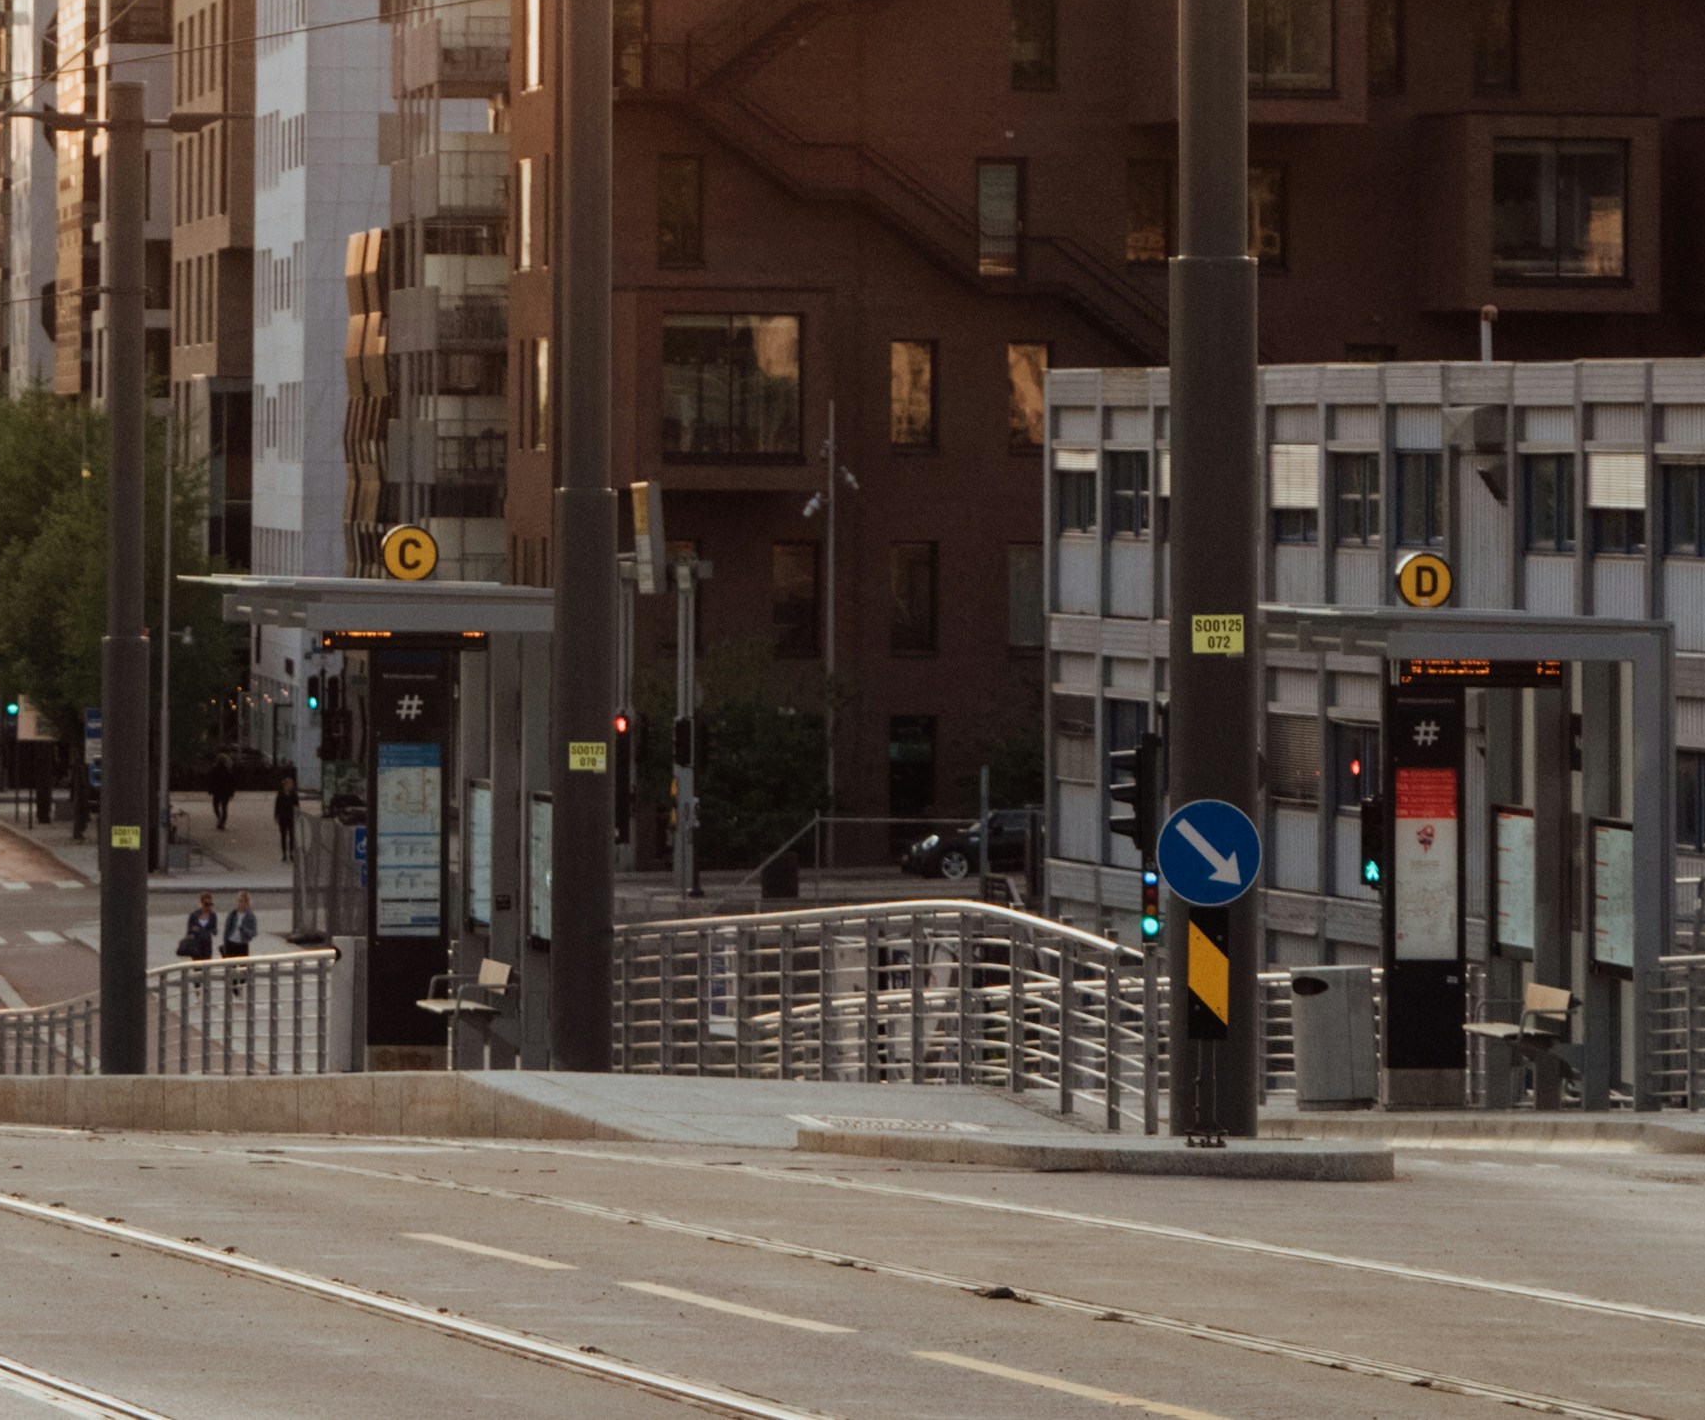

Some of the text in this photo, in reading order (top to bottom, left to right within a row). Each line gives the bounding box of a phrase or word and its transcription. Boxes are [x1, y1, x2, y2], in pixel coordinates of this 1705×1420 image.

[399, 538, 421, 569] C
[1416, 566, 1438, 597] D
[1208, 636, 1231, 649] 072
